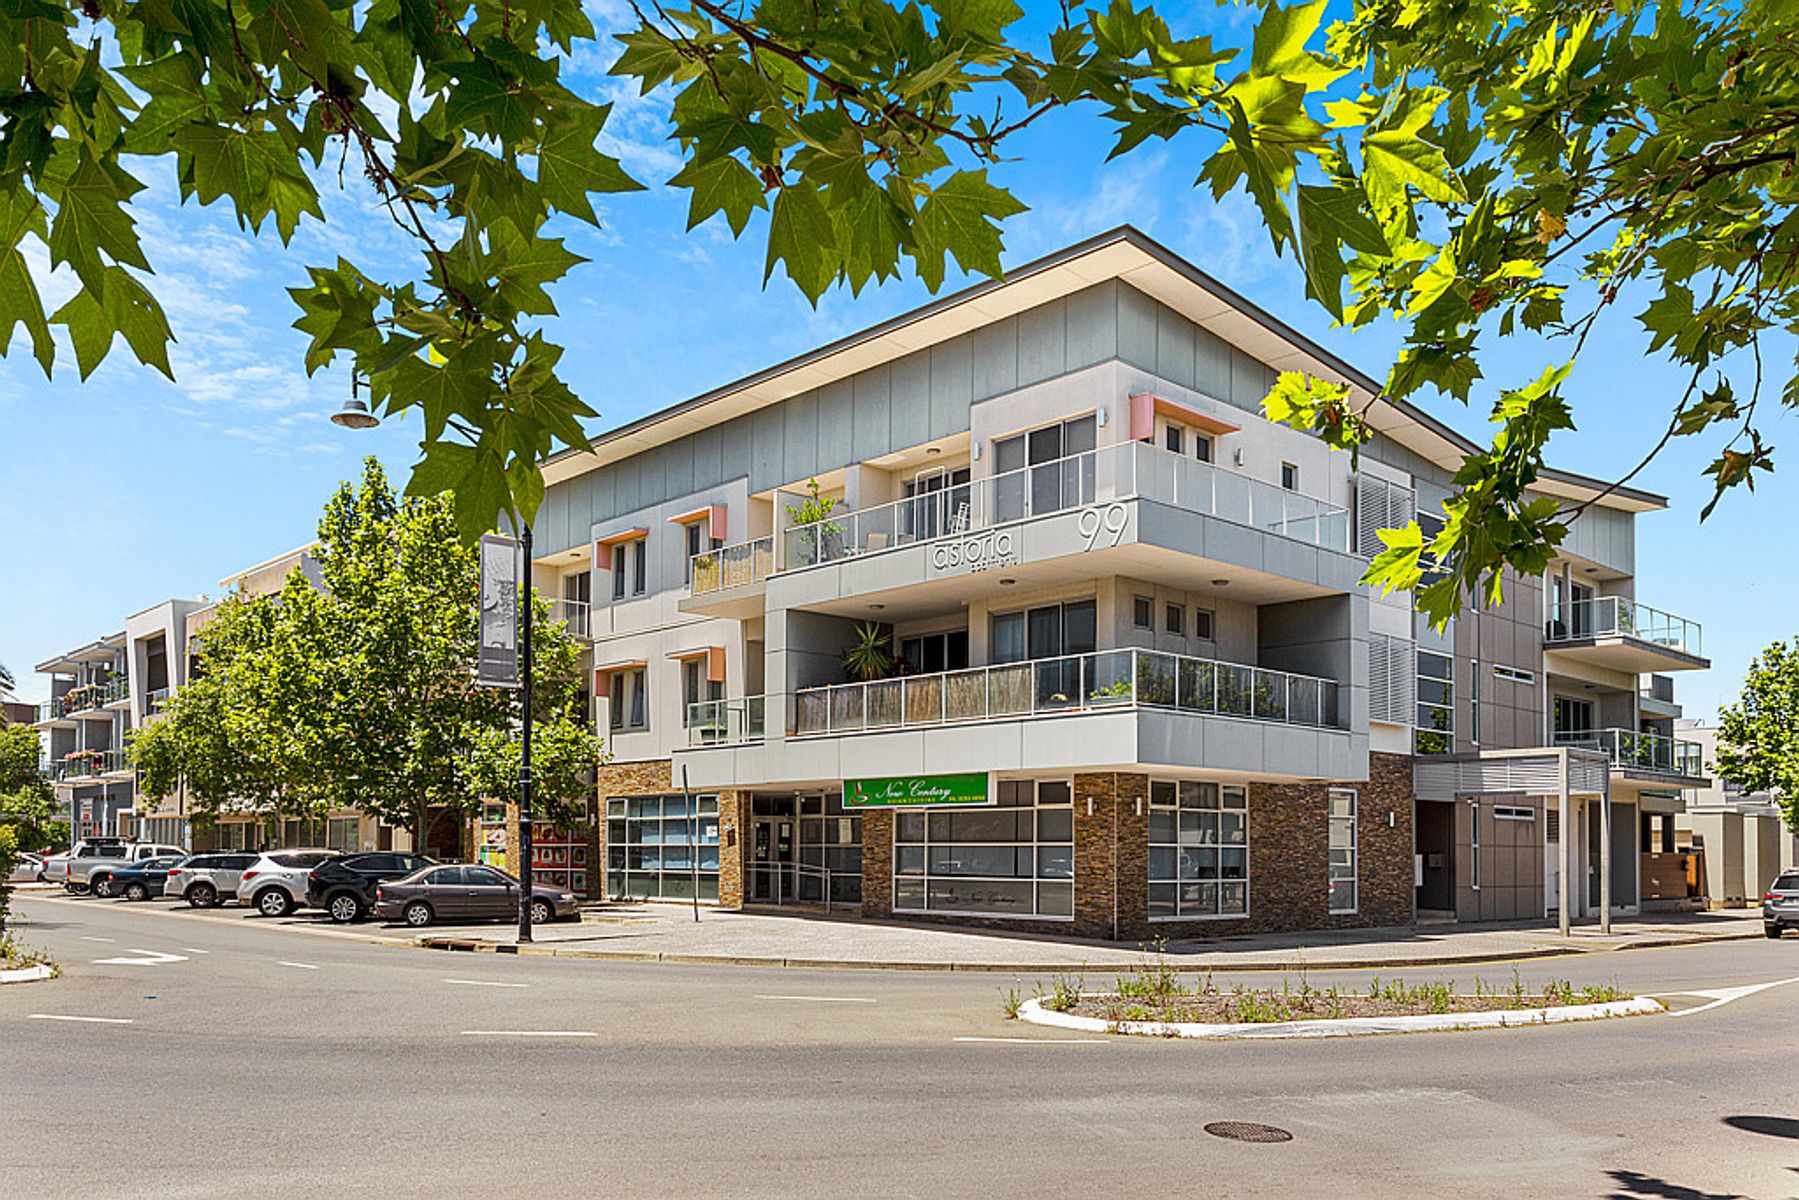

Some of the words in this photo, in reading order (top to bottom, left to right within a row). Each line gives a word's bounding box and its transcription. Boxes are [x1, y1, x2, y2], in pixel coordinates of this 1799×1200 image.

[1079, 503, 1128, 552] 99
[932, 529, 1013, 570] astoria
[876, 781, 903, 798] New
[908, 781, 951, 800] Century
